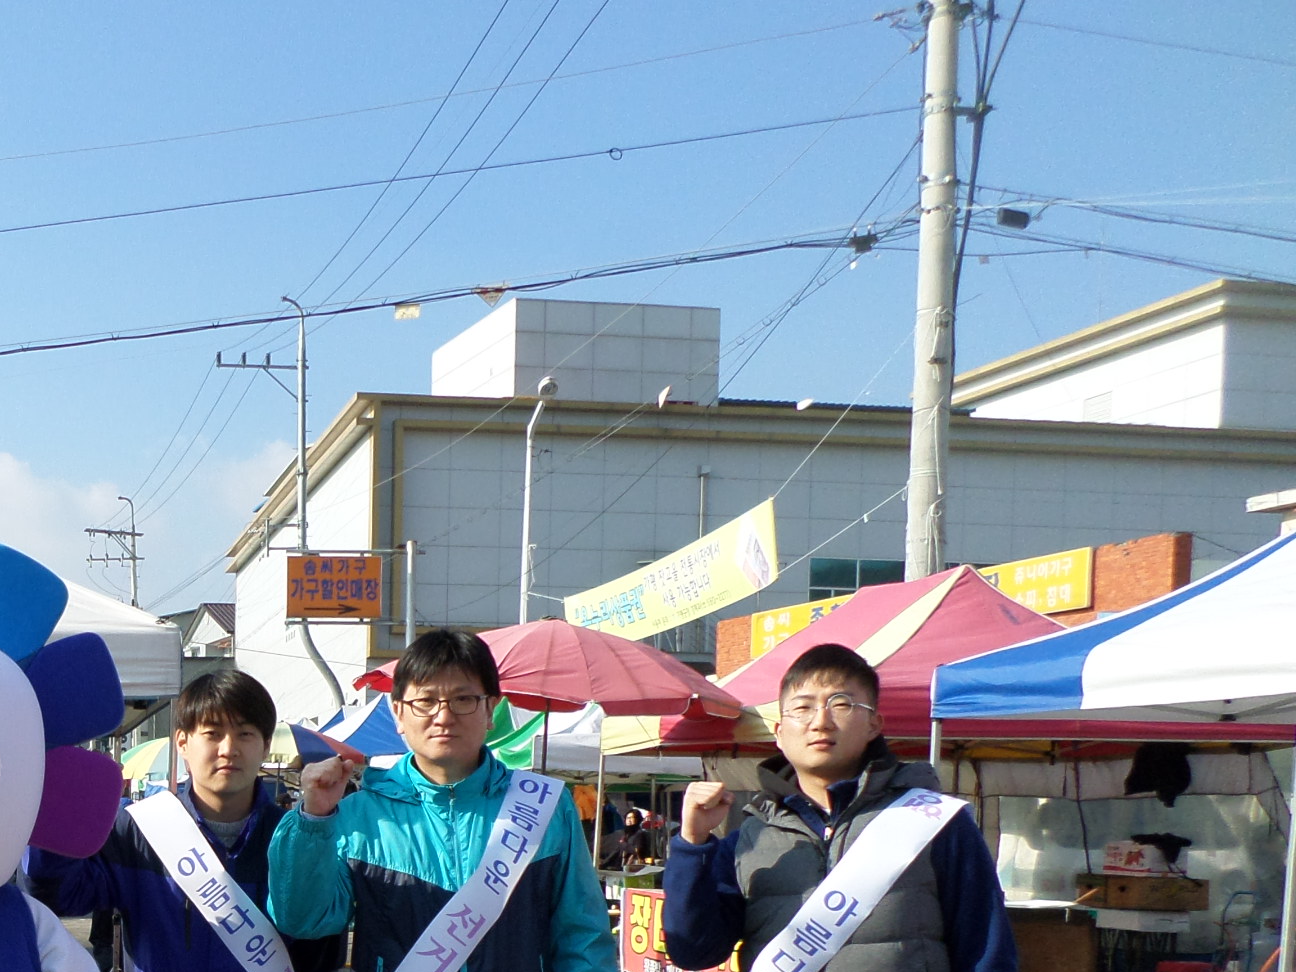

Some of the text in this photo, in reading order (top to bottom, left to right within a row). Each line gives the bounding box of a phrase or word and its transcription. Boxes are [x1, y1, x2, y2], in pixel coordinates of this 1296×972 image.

[290, 578, 379, 600] 가구할인매장
[677, 572, 711, 602] 가능합니다
[484, 778, 553, 896] 아름다운
[177, 847, 277, 967] 아름다운
